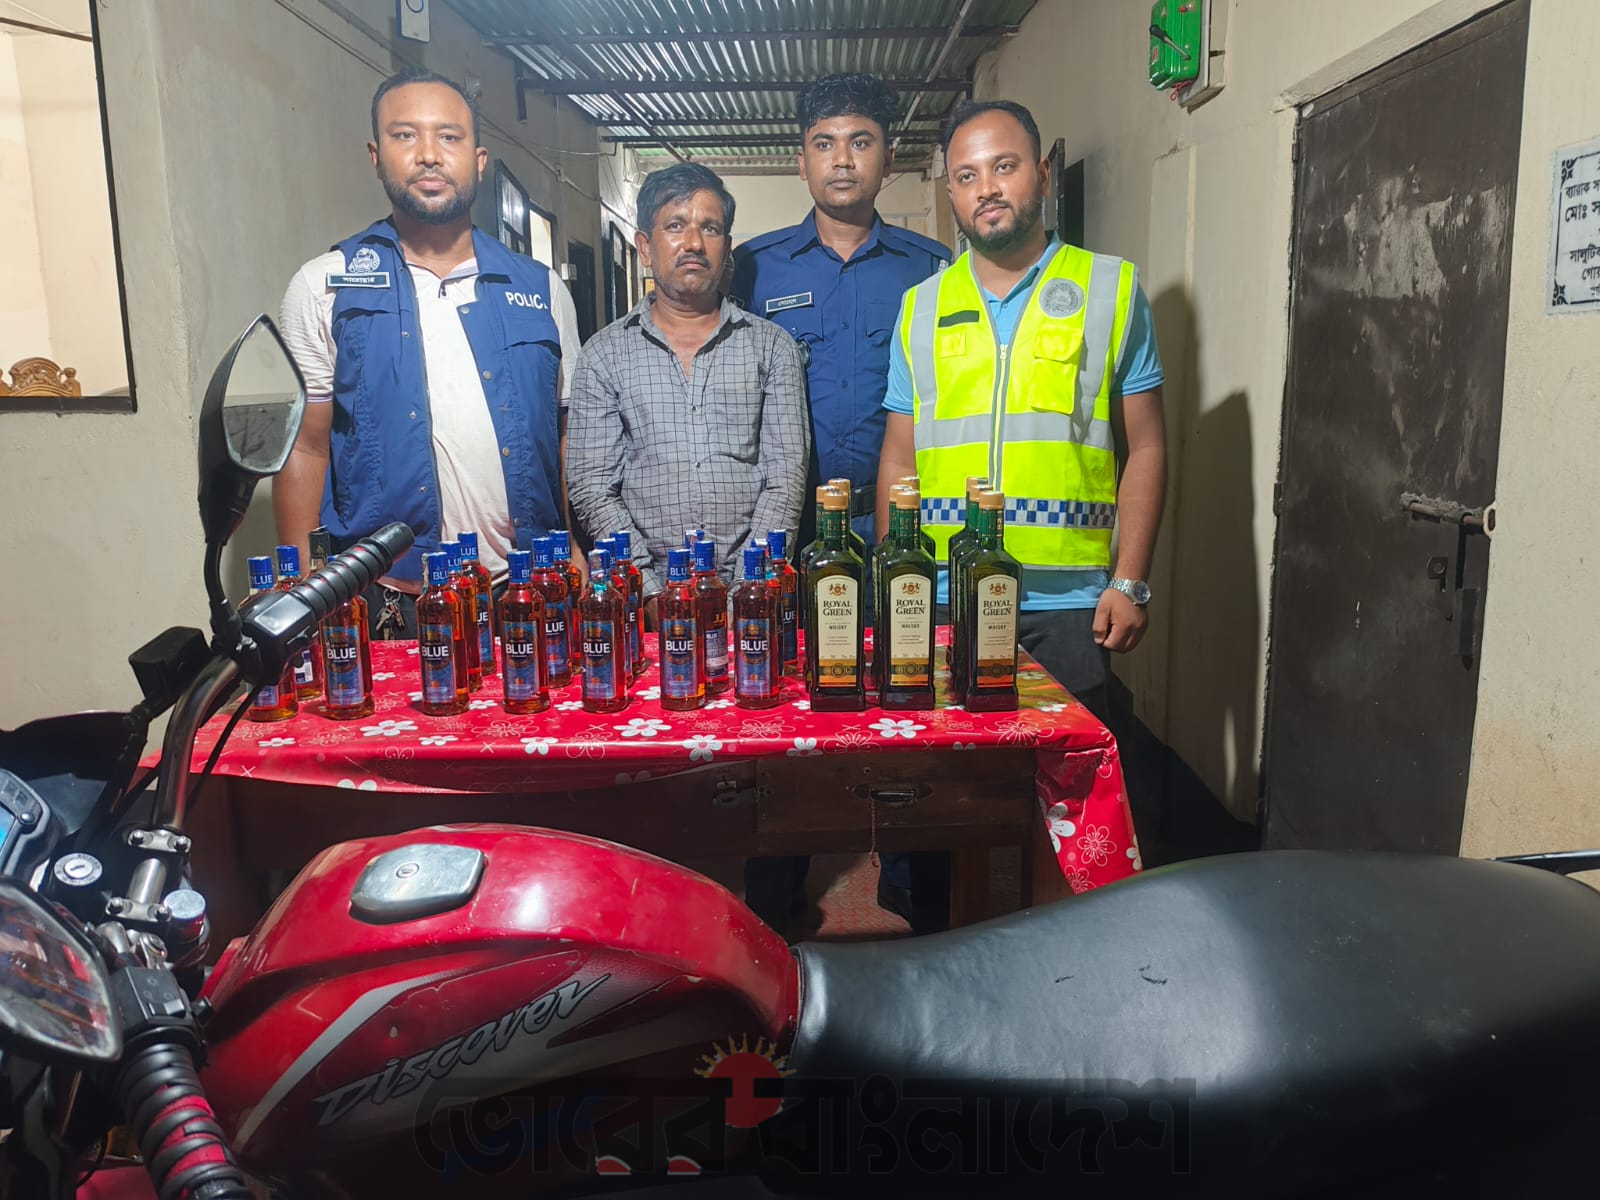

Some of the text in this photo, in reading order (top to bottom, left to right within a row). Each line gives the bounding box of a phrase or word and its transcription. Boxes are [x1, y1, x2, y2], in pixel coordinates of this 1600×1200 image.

[1565, 203, 1587, 222] মোঃ
[505, 291, 548, 309] POLIC
[460, 547, 477, 556] LUE
[554, 546, 570, 555] BLU
[432, 570, 449, 581] BLU
[670, 567, 687, 576] BLU
[823, 600, 853, 608] ROYAL
[896, 599, 926, 608] ROYAL
[983, 600, 1013, 608] ROYAL
[822, 608, 852, 616] GREEN
[895, 606, 926, 615] GREEN
[982, 607, 1012, 616] GREEN
[545, 621, 565, 633] LUE
[422, 645, 449, 657] BLUE
[505, 643, 534, 655] BLUE
[583, 642, 611, 654] BLUE
[666, 640, 694, 651] BLUE
[740, 640, 768, 651] BLUE
[327, 647, 357, 660] BLUE
